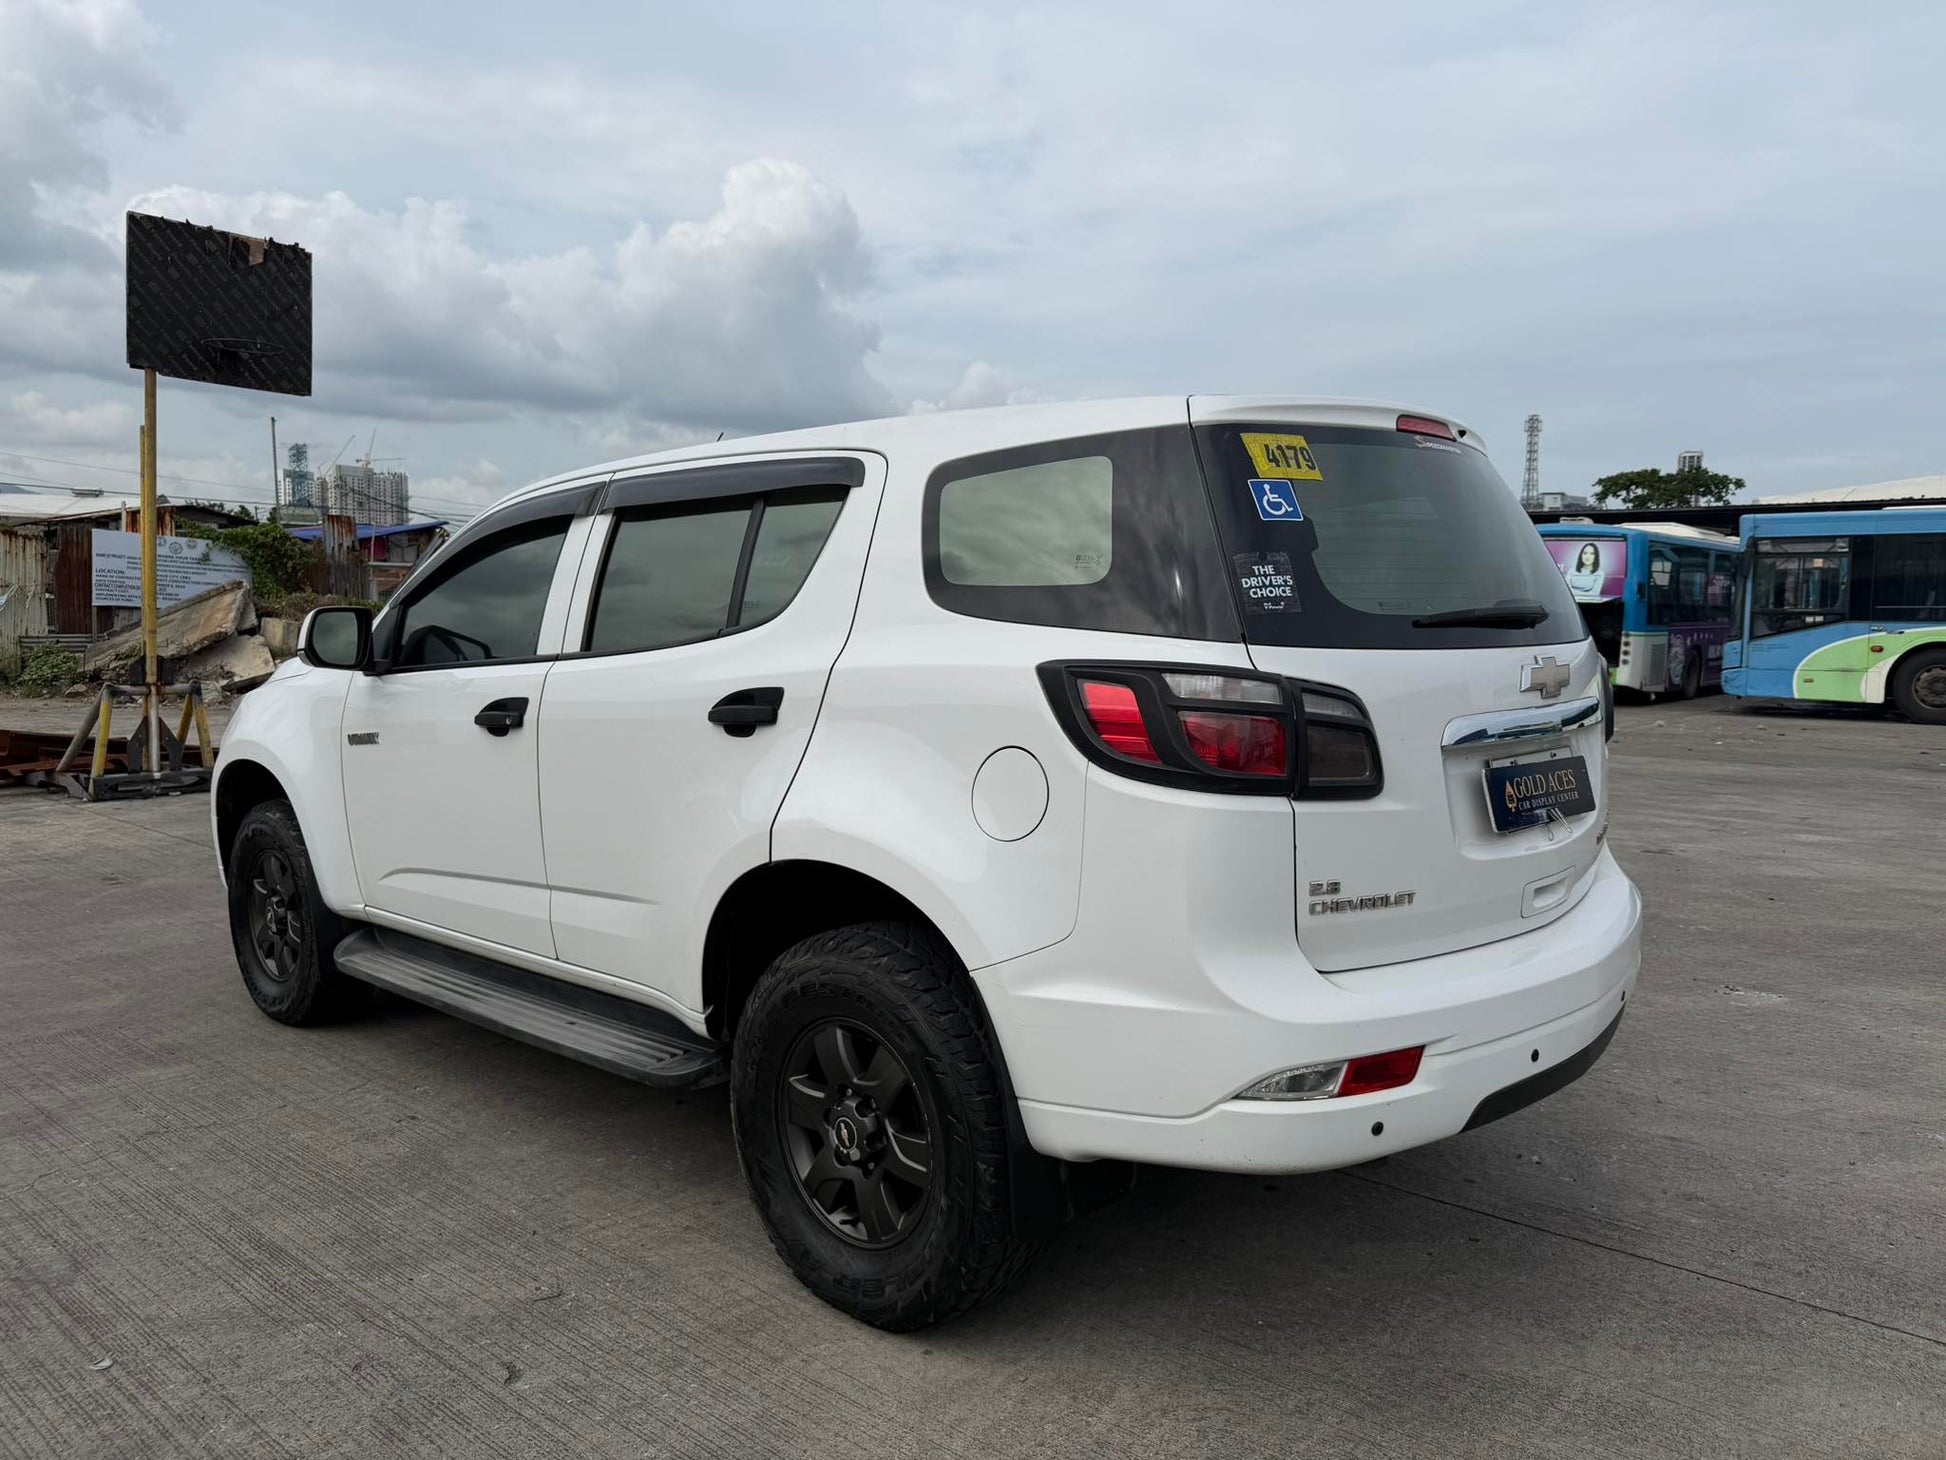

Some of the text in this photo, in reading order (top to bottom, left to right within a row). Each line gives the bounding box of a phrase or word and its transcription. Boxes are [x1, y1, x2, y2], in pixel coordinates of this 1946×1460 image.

[1264, 443, 1316, 471] 4179
[1252, 564, 1275, 575] THE
[1241, 575, 1293, 588] DRIVER'S
[1249, 586, 1292, 598] CHOICE
[1513, 769, 1576, 798] GOLD ACES
[1518, 791, 1579, 811] CAR DISPLAY CENTER
[1309, 879, 1341, 897] 2.8
[1309, 889, 1416, 916] CHEVROLET
